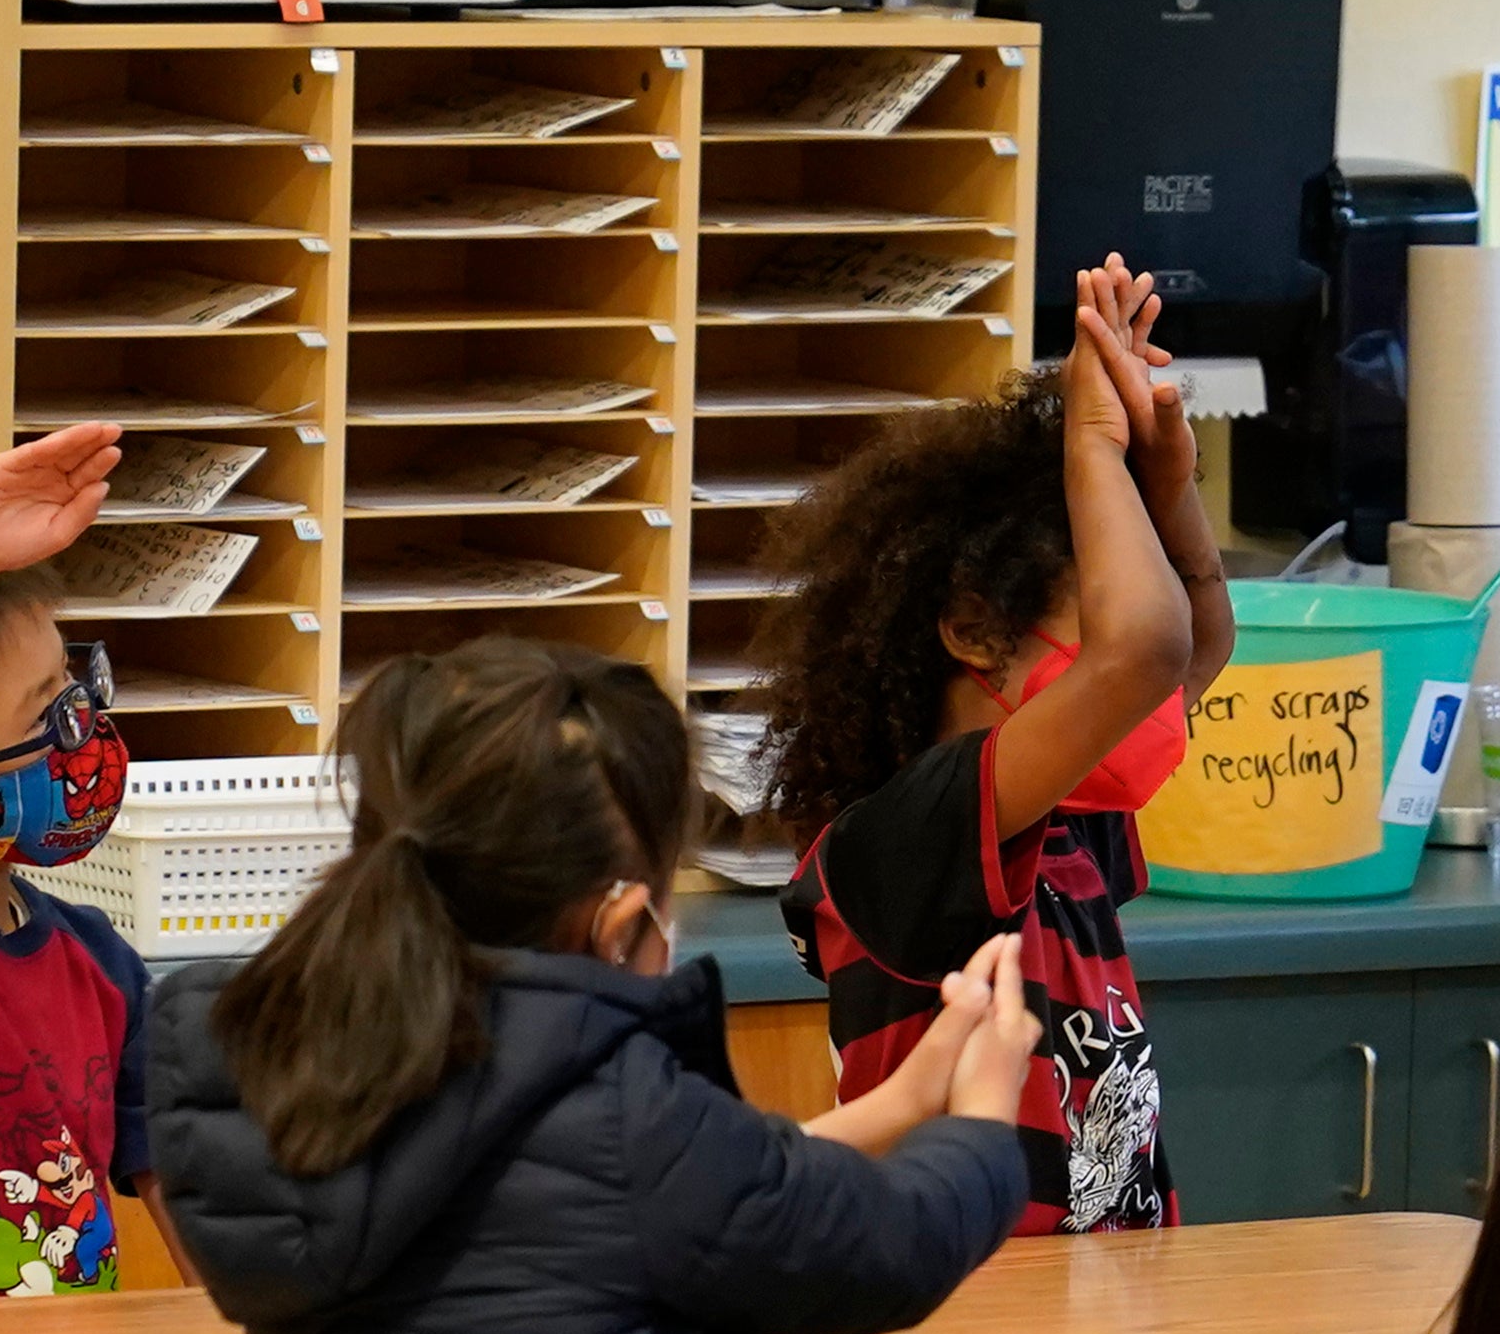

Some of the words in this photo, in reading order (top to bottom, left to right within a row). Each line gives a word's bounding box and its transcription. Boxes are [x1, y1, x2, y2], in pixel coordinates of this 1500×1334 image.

[1145, 176, 1212, 194] PACIFIC
[1144, 194, 1184, 212] BLUE
[1271, 686, 1370, 730] scraps
